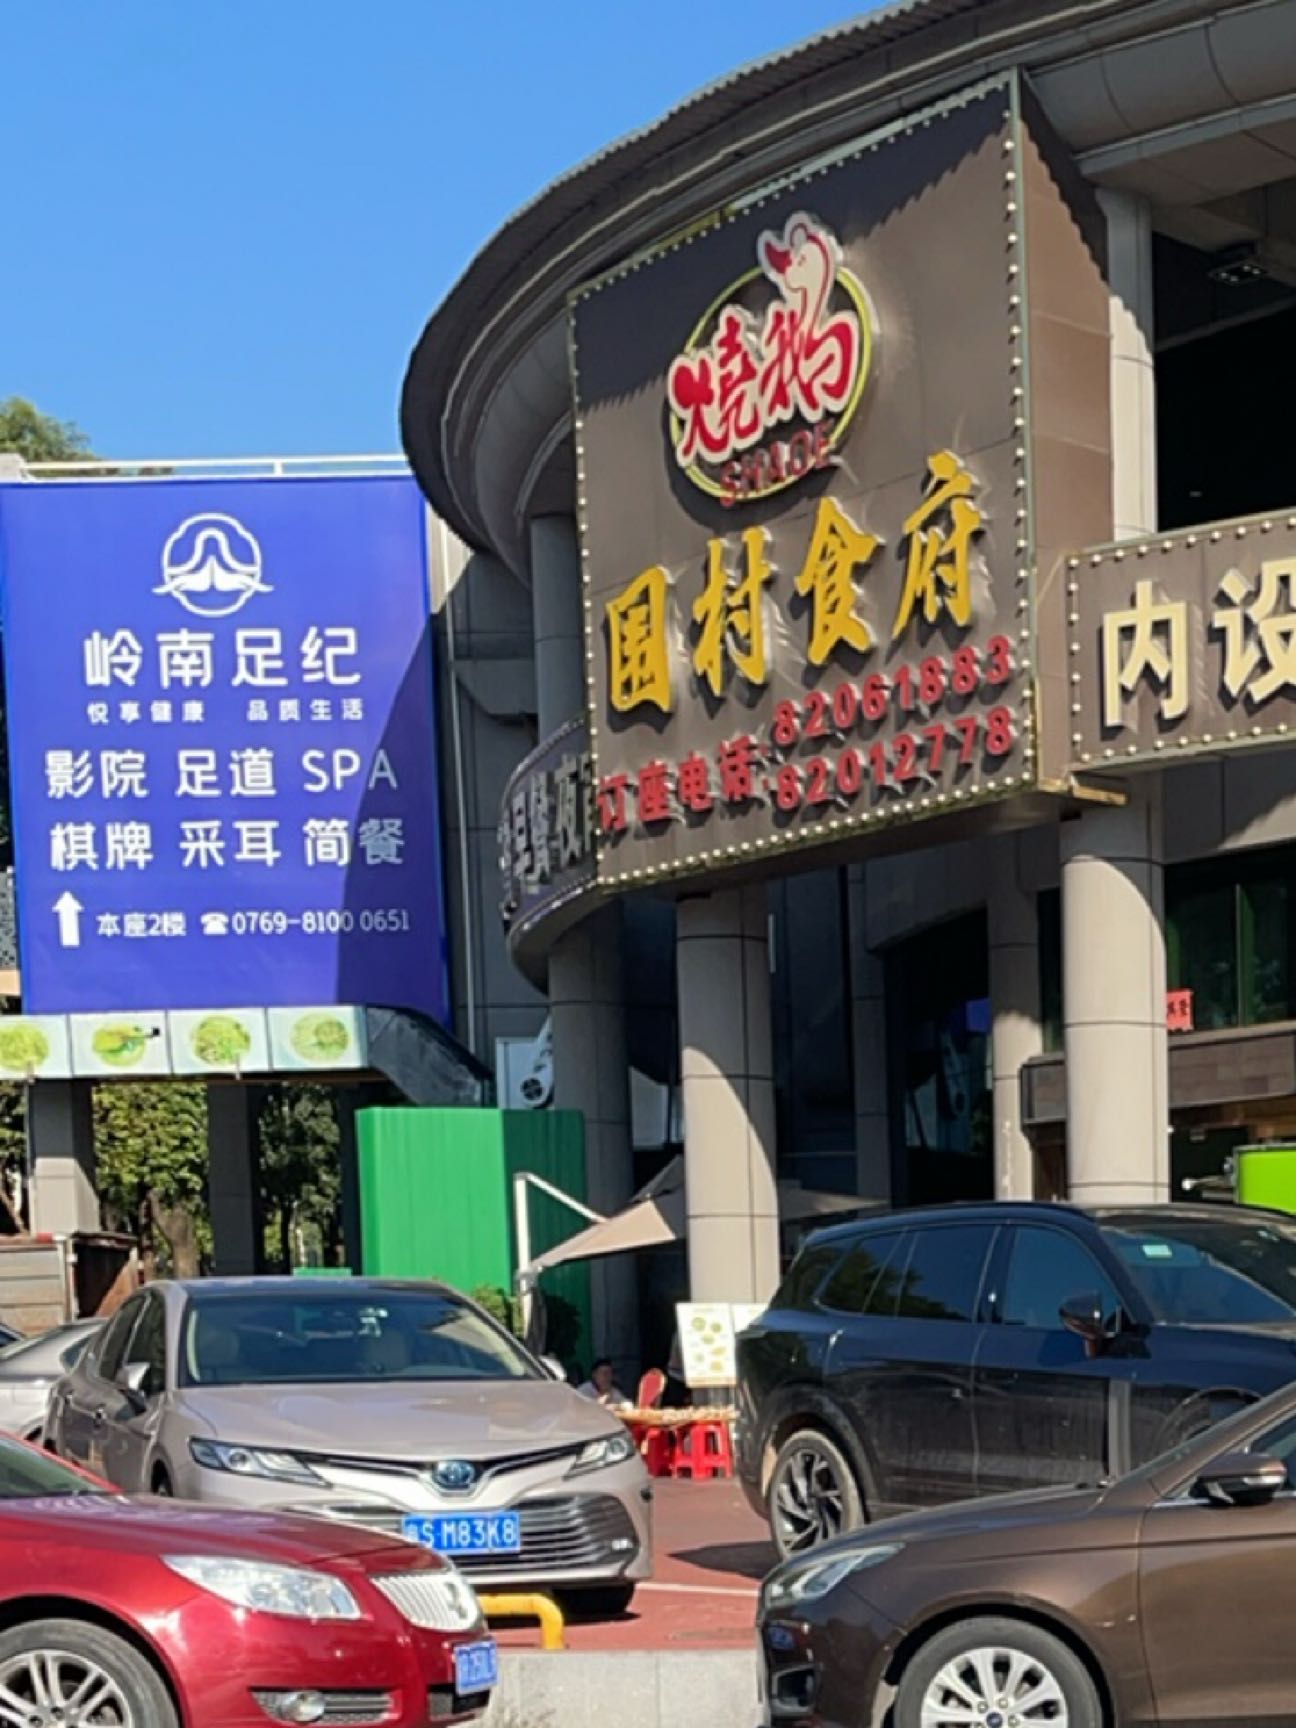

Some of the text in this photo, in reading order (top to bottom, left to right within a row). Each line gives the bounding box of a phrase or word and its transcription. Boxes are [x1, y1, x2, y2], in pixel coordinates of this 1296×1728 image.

[84, 627, 361, 688] 岭南足纪
[247, 698, 363, 722] 品质生活
[774, 636, 1012, 744] 82061883
[45, 747, 397, 798] 影院 足道 SPA
[776, 704, 1014, 811] 82012778
[51, 817, 404, 870] 棋牌 采耳 简餐
[97, 912, 186, 937] 本座2楼
